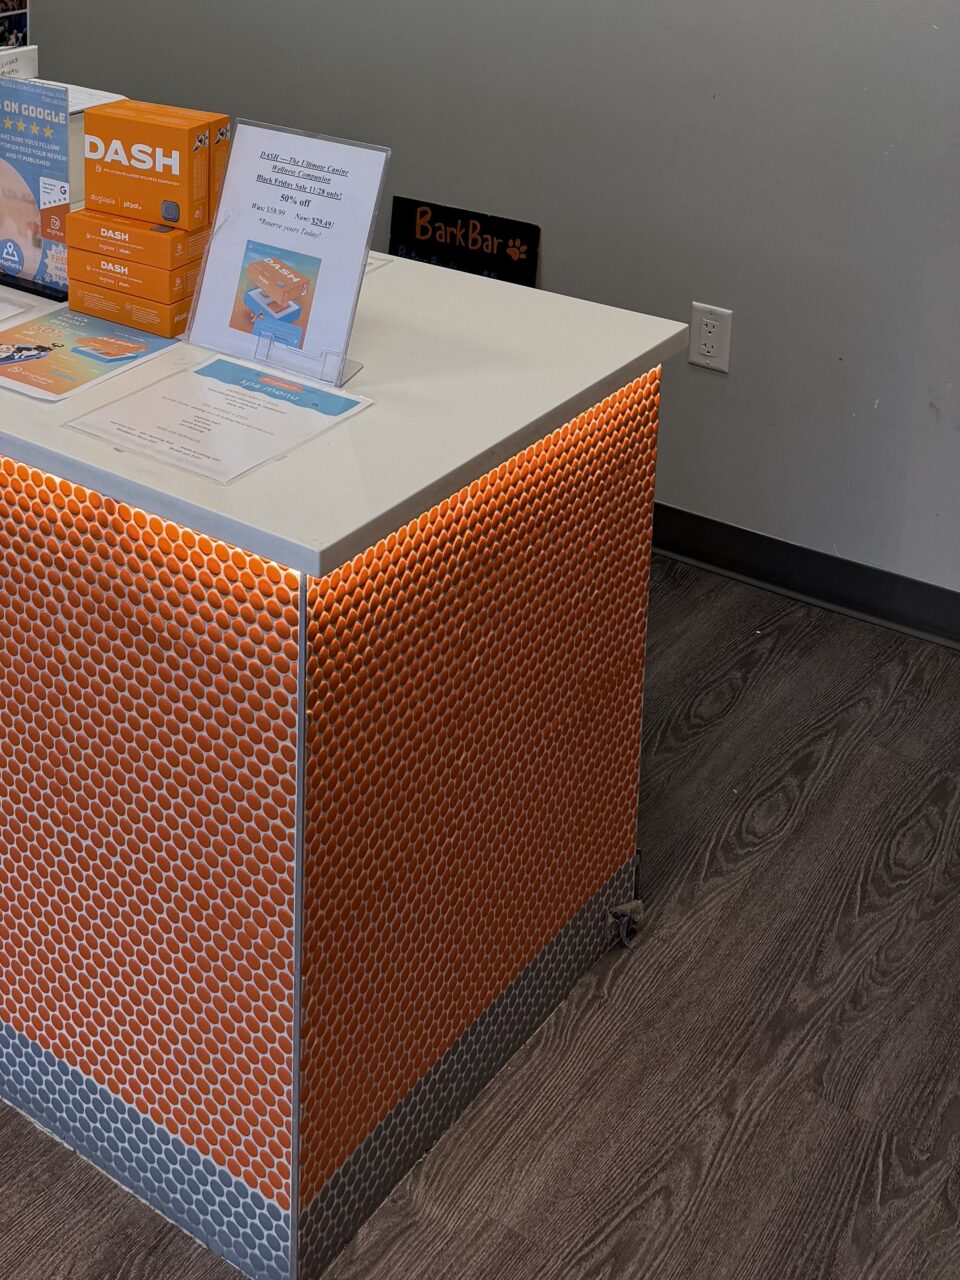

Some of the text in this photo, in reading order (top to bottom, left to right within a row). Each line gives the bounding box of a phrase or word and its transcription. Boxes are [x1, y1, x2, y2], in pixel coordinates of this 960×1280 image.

[3, 100, 19, 114] ON
[21, 104, 66, 124] GOOGLE
[5, 151, 16, 159] AND
[39, 141, 61, 151] FELLOW
[84, 134, 180, 176] DASH
[46, 151, 67, 161] REVIEW
[260, 151, 280, 160] DASH
[301, 160, 326, 171] Ultimate
[326, 165, 349, 176] Canine
[256, 173, 272, 184] Black
[274, 178, 294, 190] Friday
[294, 183, 307, 192] Sale
[272, 164, 332, 184] Wellness Companion
[279, 194, 312, 208] 50% off
[251, 202, 266, 212] Was:
[294, 212, 310, 223] Now:
[100, 228, 129, 241] DASH
[283, 224, 300, 234] yours
[100, 261, 129, 275] DASH
[263, 258, 300, 282] DASH
[240, 378, 260, 390] spa
[262, 386, 300, 401] menu
